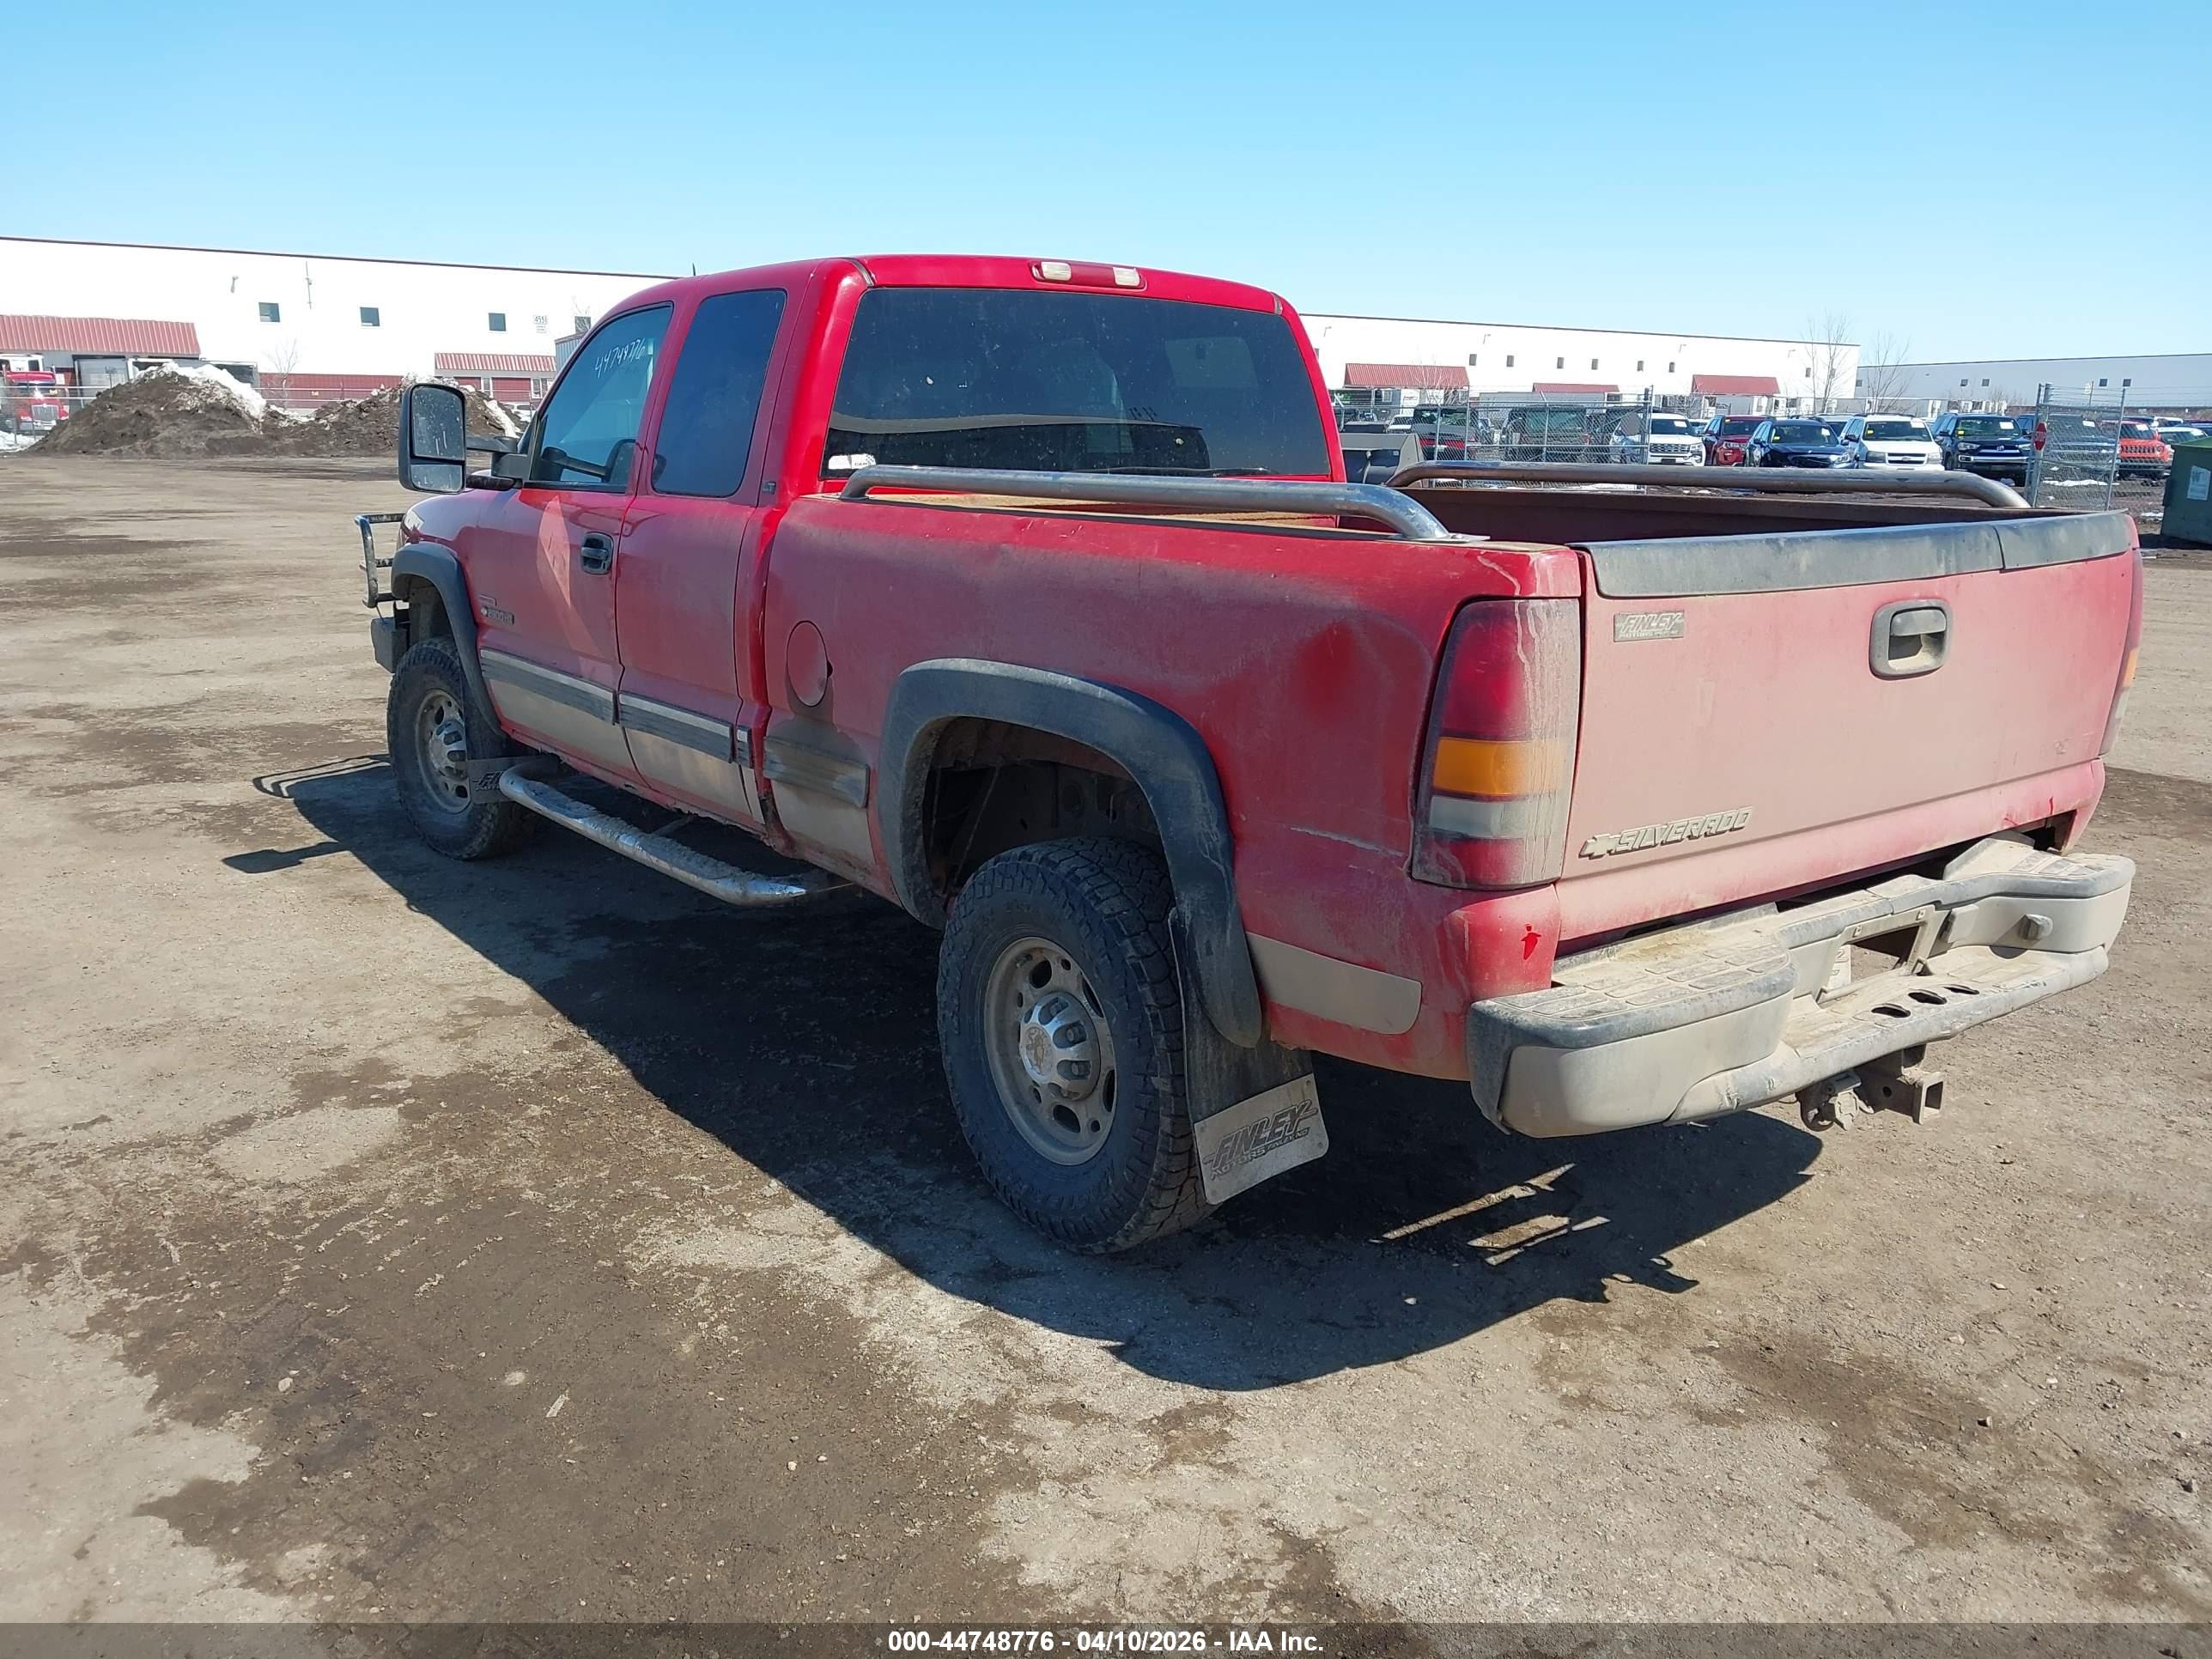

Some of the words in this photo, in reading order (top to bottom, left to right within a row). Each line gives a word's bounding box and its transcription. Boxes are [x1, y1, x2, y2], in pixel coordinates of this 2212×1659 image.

[1620, 612, 1682, 633] FINLEY
[1614, 805, 1753, 853] SILVERADO
[1204, 1100, 1319, 1170] FINLEY
